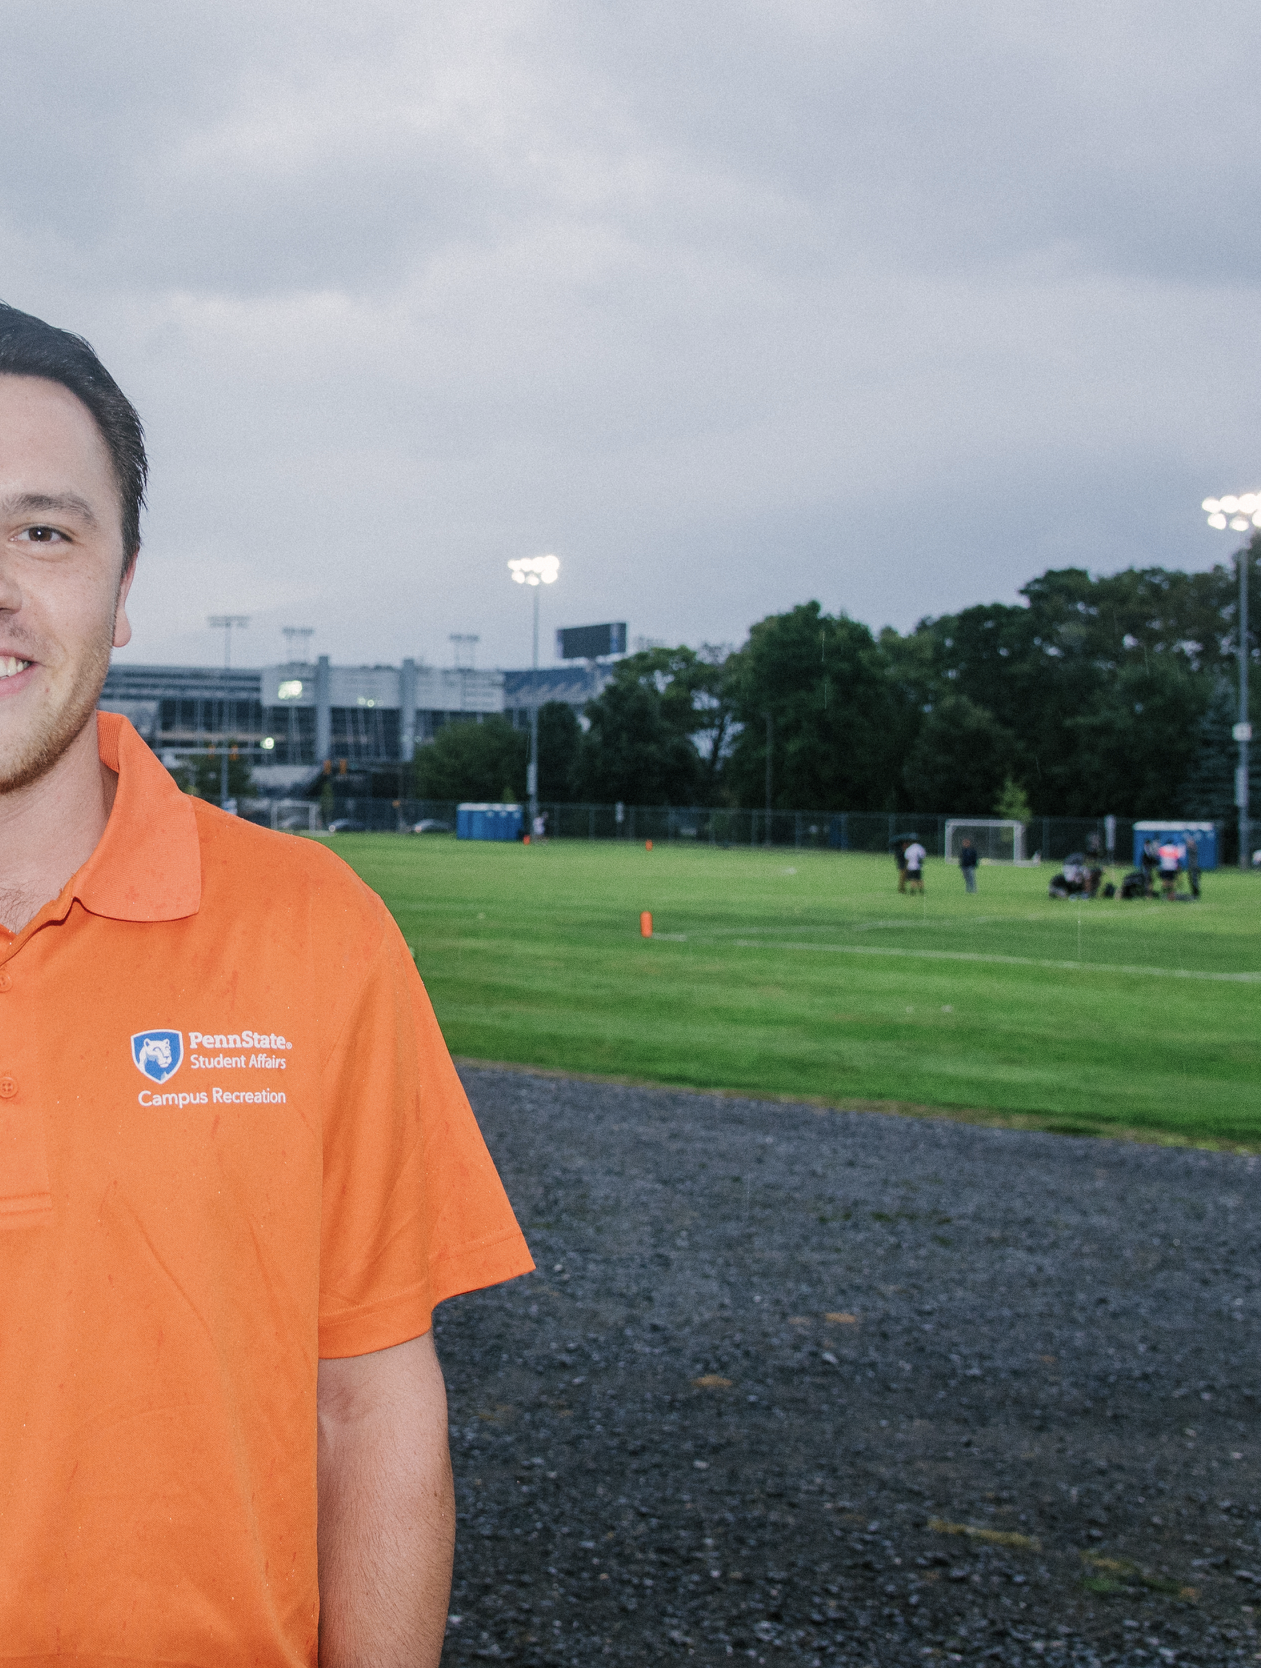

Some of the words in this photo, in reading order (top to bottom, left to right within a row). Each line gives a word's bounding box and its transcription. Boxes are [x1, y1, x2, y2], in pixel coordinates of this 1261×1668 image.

[190, 1053, 246, 1069] Student
[249, 1053, 286, 1069] Affairs
[138, 1090, 208, 1109] Campus
[212, 1087, 286, 1104] Recreation
